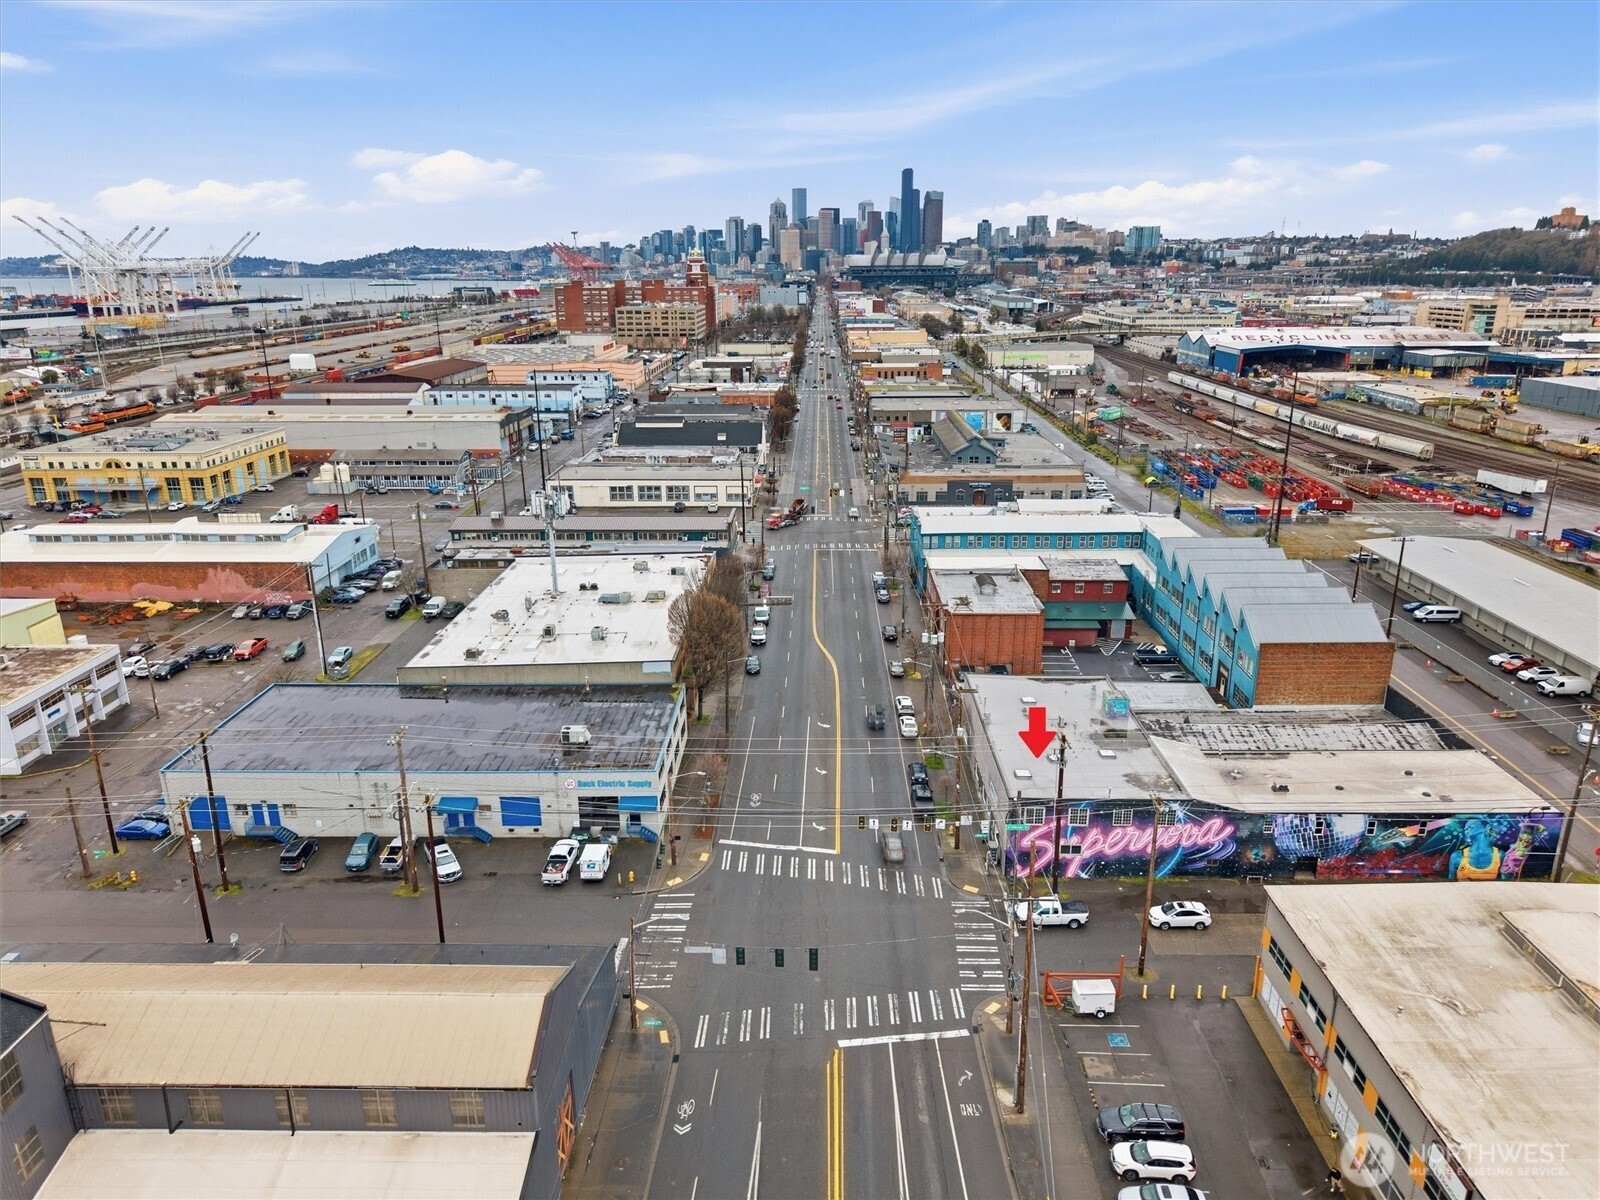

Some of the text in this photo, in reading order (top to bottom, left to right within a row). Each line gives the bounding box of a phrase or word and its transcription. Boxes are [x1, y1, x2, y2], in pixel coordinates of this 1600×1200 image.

[1231, 333, 1451, 342] RECYCLING CENTER
[597, 780, 625, 788] Electric
[627, 780, 652, 789] Supply
